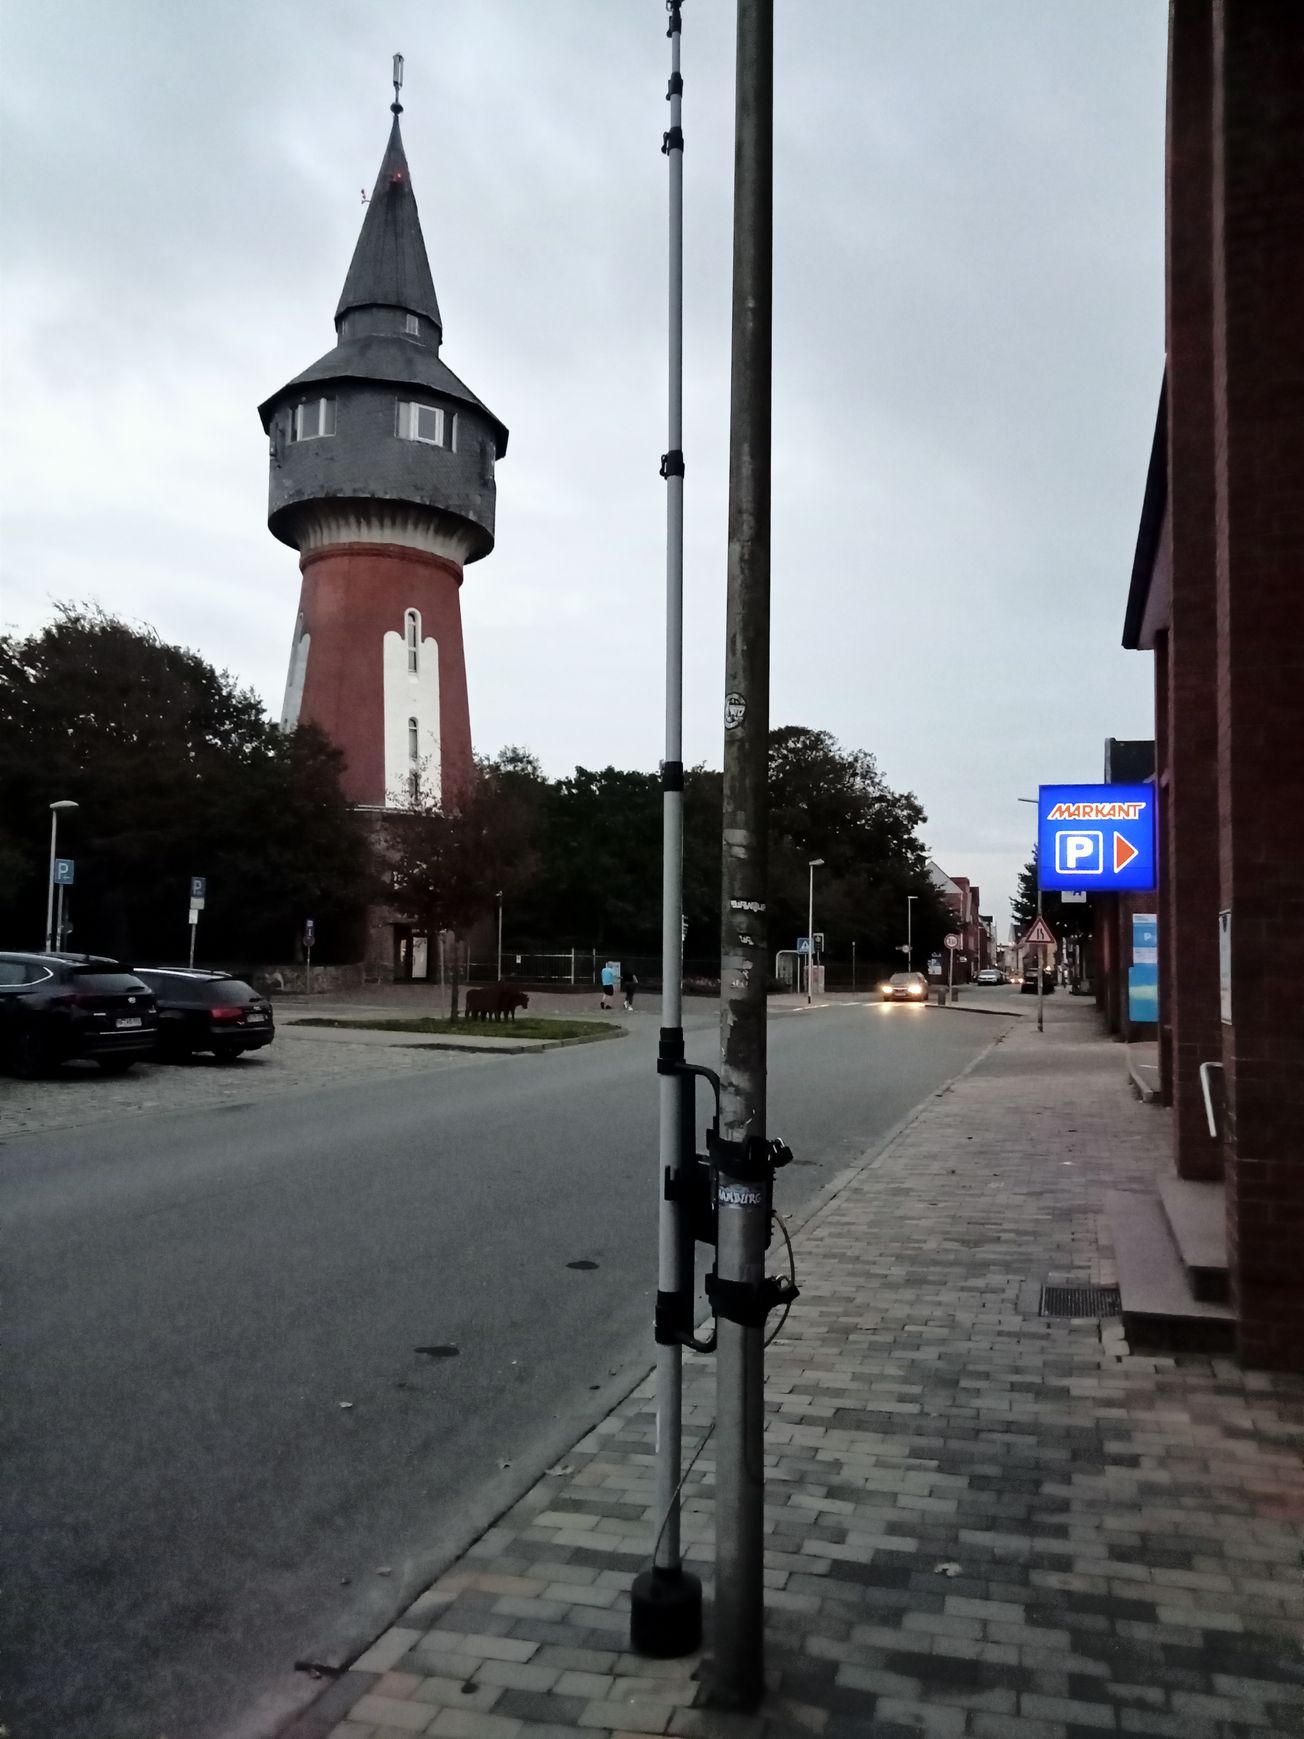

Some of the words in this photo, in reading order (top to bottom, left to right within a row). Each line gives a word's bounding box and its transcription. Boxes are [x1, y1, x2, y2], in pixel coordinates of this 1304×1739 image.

[1047, 803, 1146, 820] MARKANT
[1066, 836, 1094, 869] P
[58, 862, 69, 880] P
